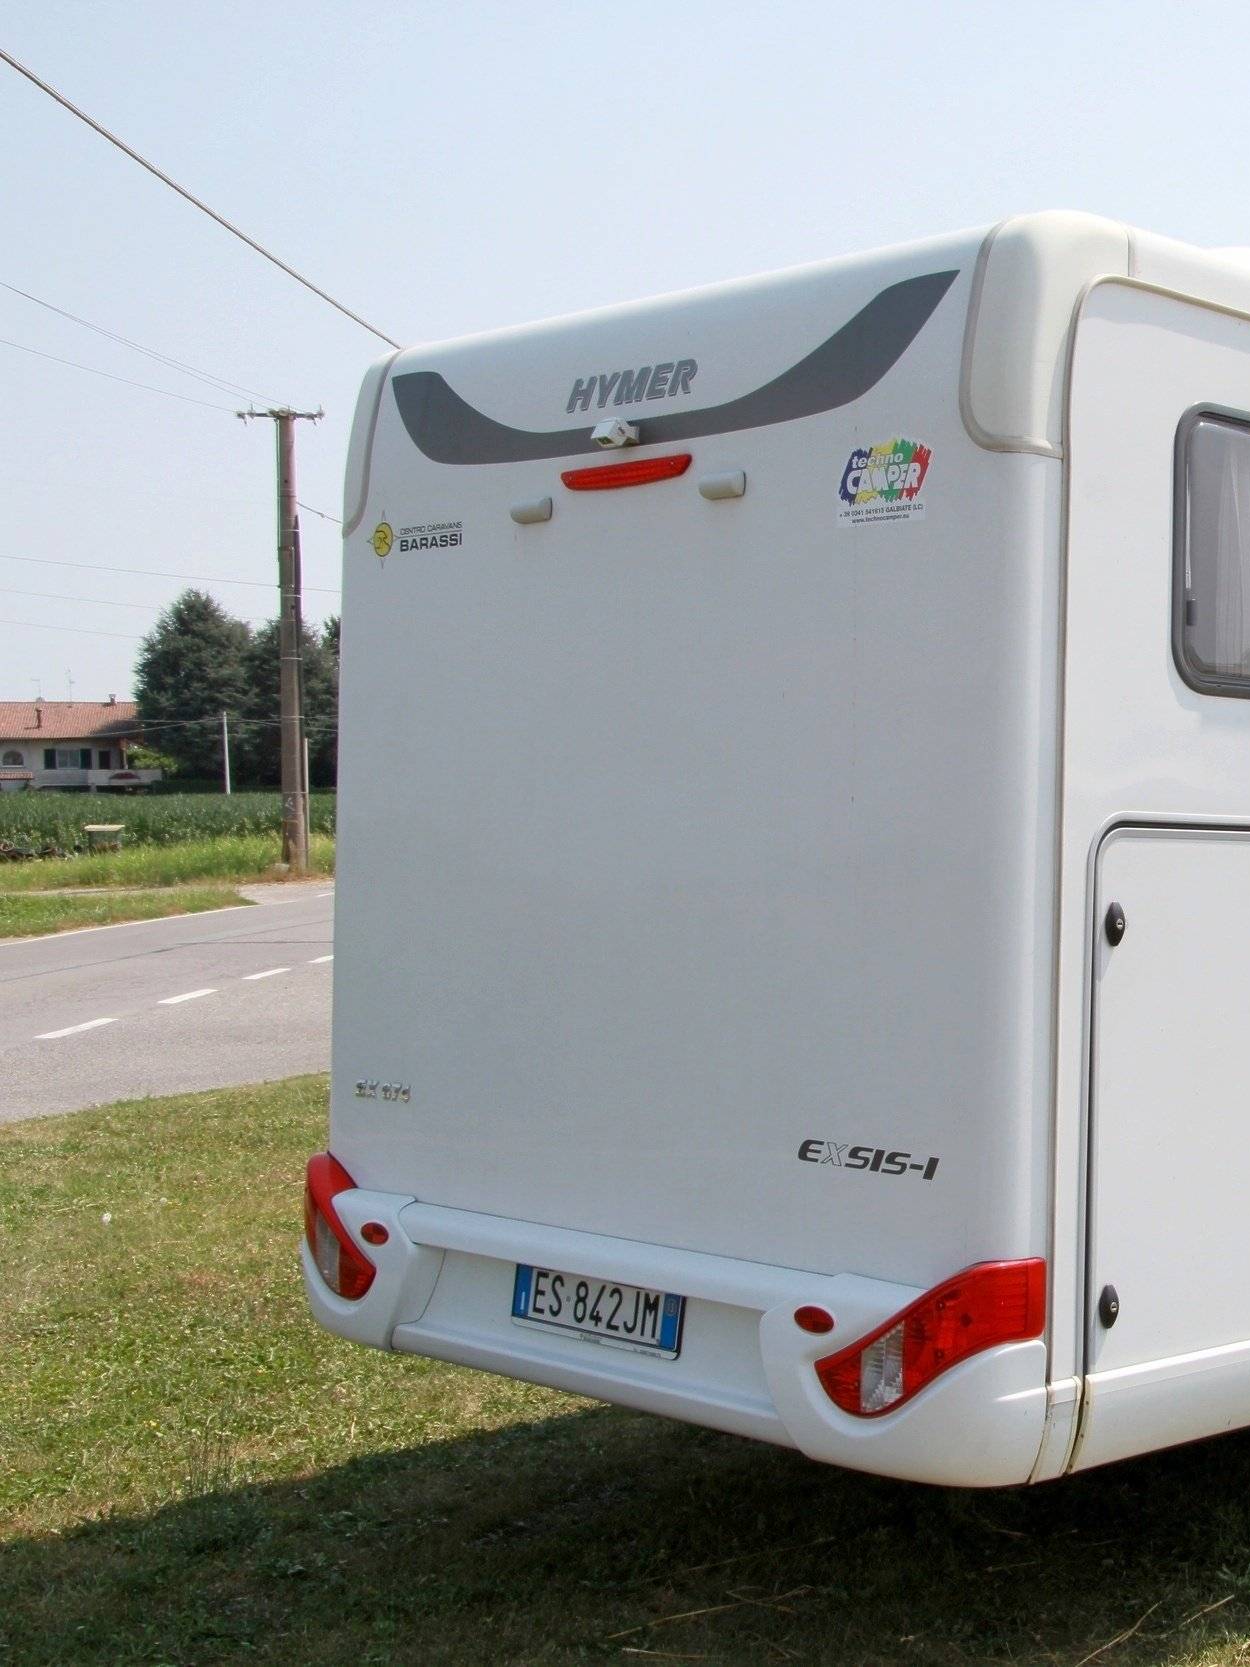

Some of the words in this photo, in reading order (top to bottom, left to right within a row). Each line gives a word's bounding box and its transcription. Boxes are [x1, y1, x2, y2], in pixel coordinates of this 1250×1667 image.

[566, 359, 699, 414] HYMER
[852, 453, 904, 469] techno
[846, 462, 922, 495] CAMPER
[400, 526, 426, 536] CENTRO
[427, 520, 463, 532] CARAVANS
[400, 533, 463, 553] BARASSI
[798, 1139, 940, 1181] EXSIS-I
[532, 1271, 565, 1317] ES
[573, 1281, 661, 1339] 842JM
